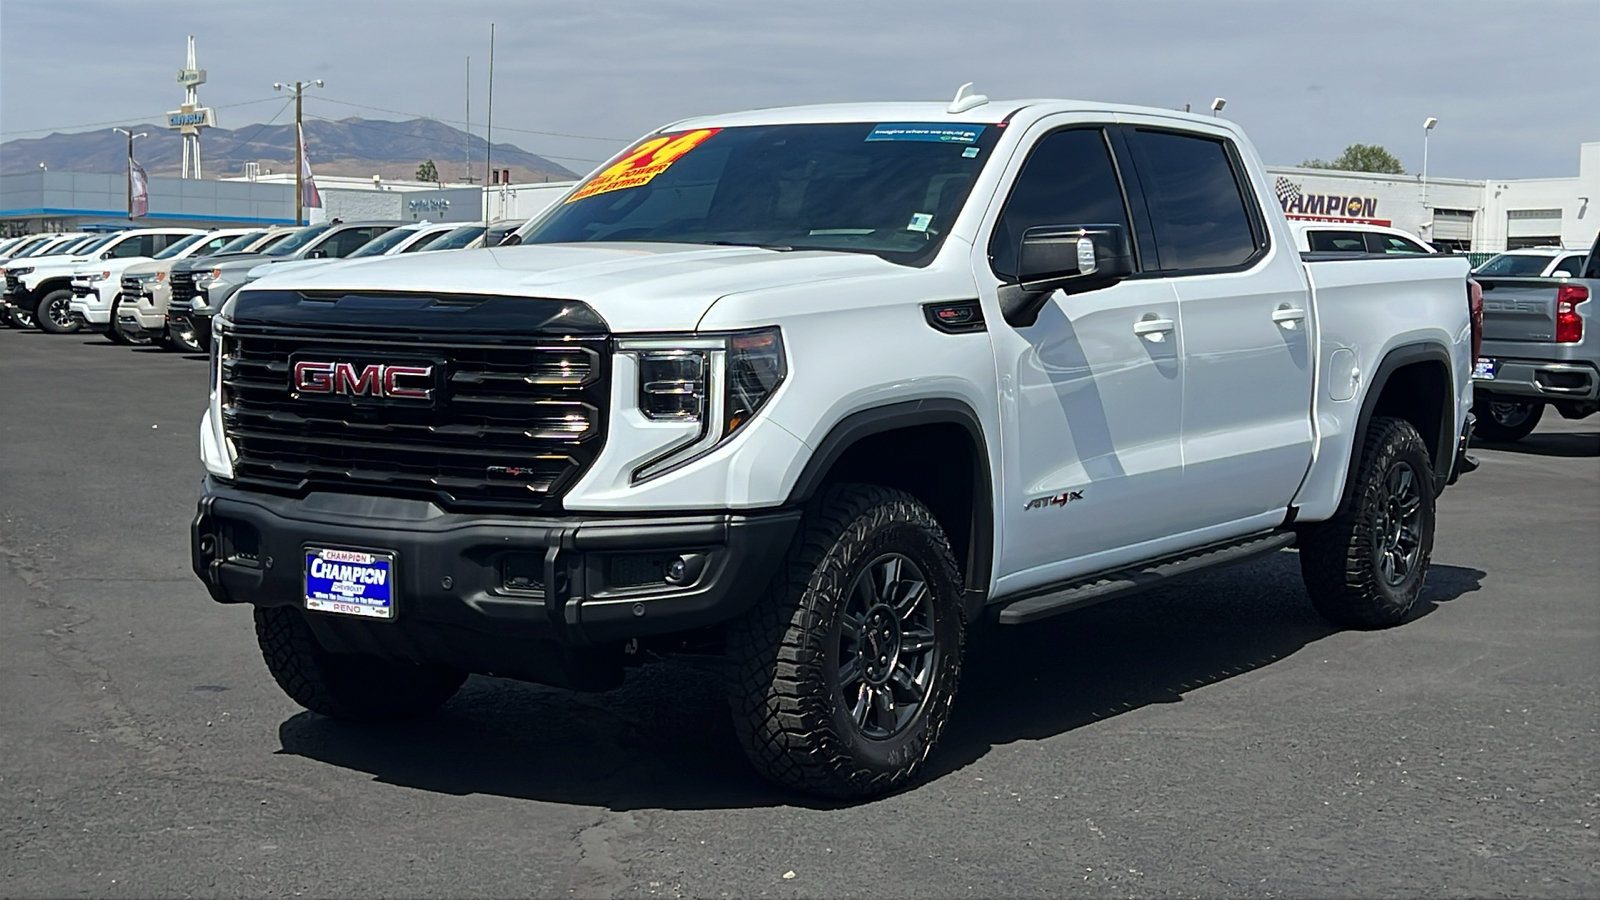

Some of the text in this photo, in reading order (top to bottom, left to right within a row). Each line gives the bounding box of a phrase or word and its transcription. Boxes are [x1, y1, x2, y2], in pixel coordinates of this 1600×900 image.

[616, 163, 669, 181] POWER
[294, 361, 434, 399] GMC
[326, 551, 367, 563] CHAMPION
[310, 557, 387, 586] CHAMPION
[333, 603, 361, 613] RENO
